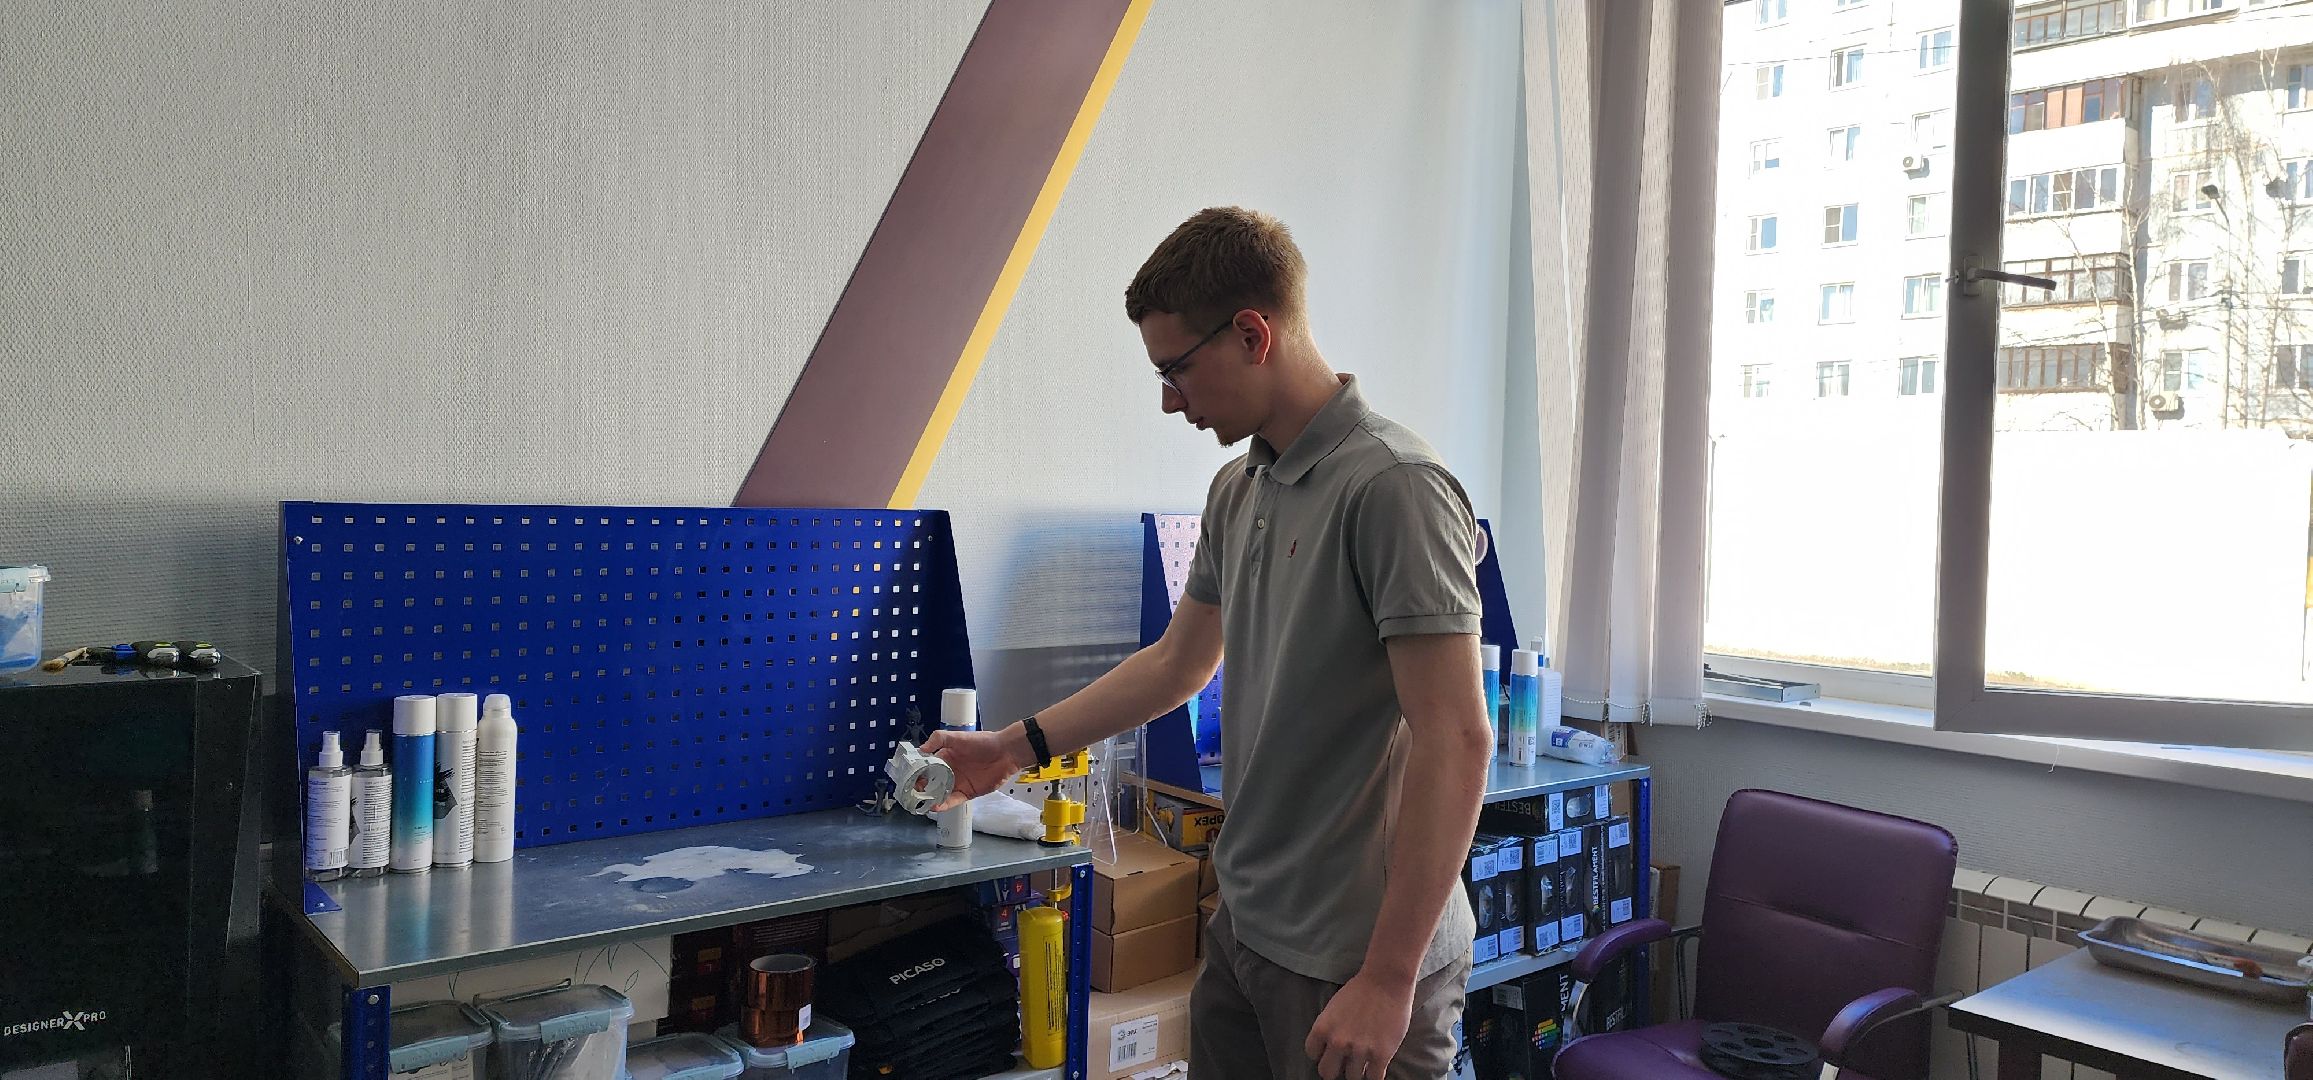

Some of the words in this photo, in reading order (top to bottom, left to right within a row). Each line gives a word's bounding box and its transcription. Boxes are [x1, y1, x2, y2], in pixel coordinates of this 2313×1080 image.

[1194, 814, 1225, 828] OPEX
[1591, 846, 1599, 905] BESTFILAMENT
[889, 958, 945, 985] PICASO
